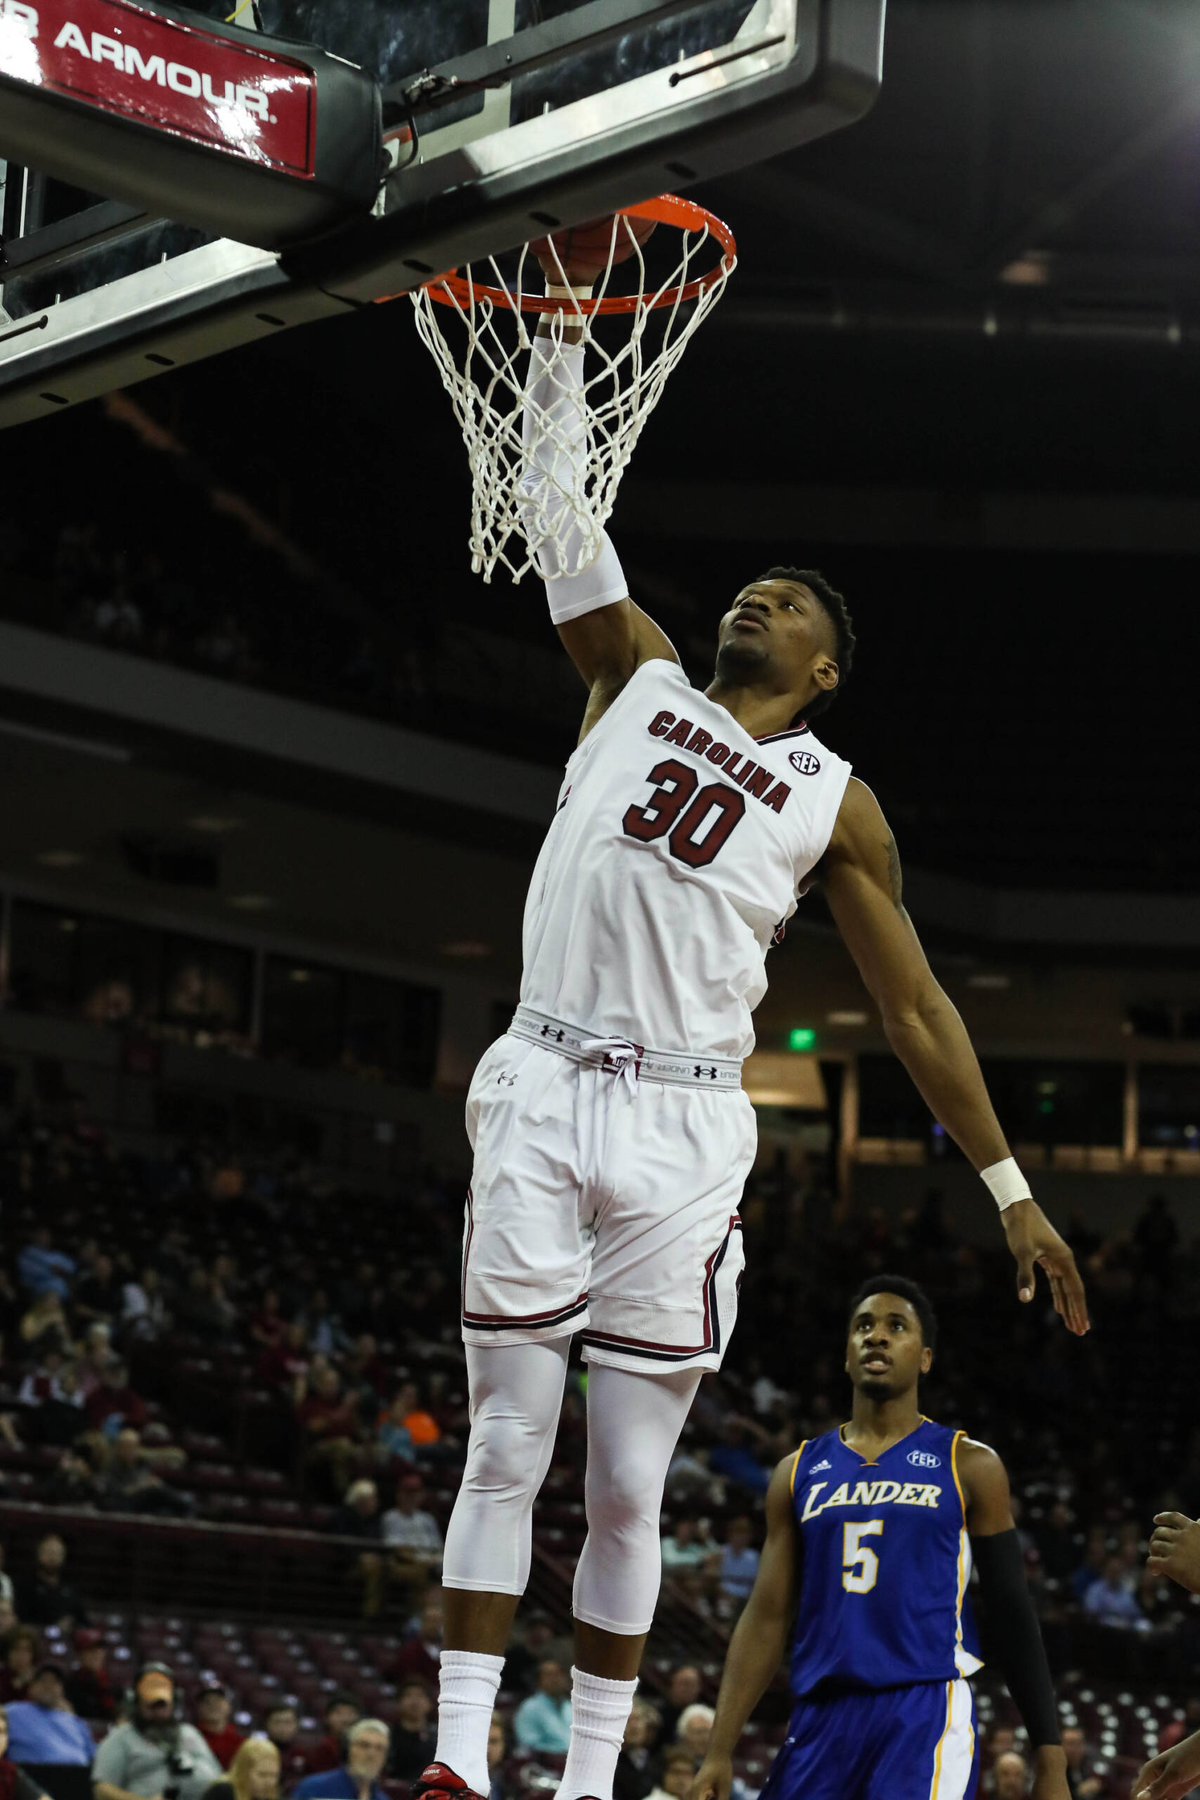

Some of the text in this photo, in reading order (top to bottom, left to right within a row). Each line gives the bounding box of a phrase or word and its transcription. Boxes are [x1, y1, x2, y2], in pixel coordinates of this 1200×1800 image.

[647, 710, 792, 814] CAROLINA
[791, 752, 819, 774] SEC
[622, 758, 746, 869] 30
[911, 1451, 936, 1467] FEH
[801, 1480, 942, 1523] LANDER
[842, 1519, 884, 1594] 5
